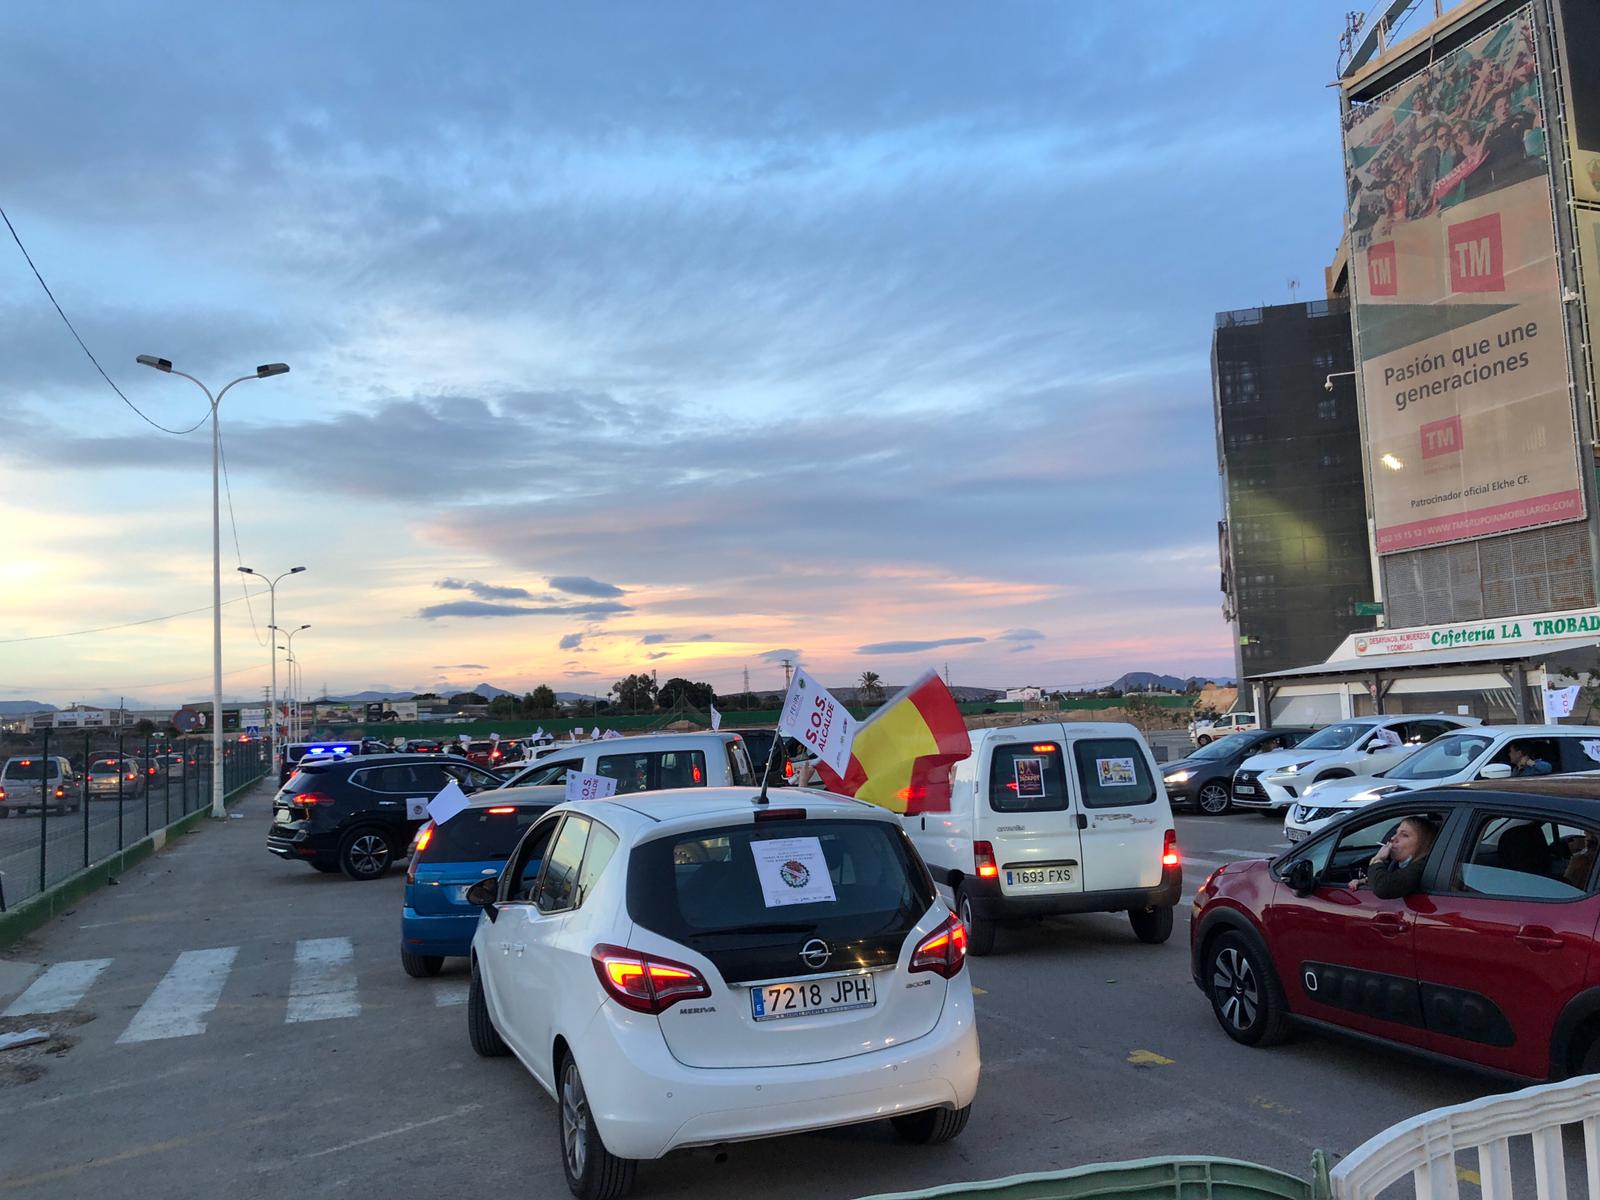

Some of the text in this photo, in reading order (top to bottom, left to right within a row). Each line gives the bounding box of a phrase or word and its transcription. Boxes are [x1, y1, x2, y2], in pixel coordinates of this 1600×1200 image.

[1371, 256, 1392, 285] TM
[1455, 237, 1492, 278] TM
[1384, 322, 1538, 386] Pasión que une
[1395, 351, 1529, 411] generaciones
[1426, 427, 1454, 449] TM
[1411, 491, 1461, 508] Patrocinador
[1464, 483, 1490, 497] oficial
[1492, 480, 1515, 491] Elche
[1431, 615, 1600, 647] Cafetería LA TROBAD
[805, 695, 827, 744] S.O.S.
[818, 702, 835, 752] ALCALDE
[1016, 869, 1071, 883] 1693 FXS
[768, 984, 822, 1012] 7218
[830, 979, 868, 1003] JPH
